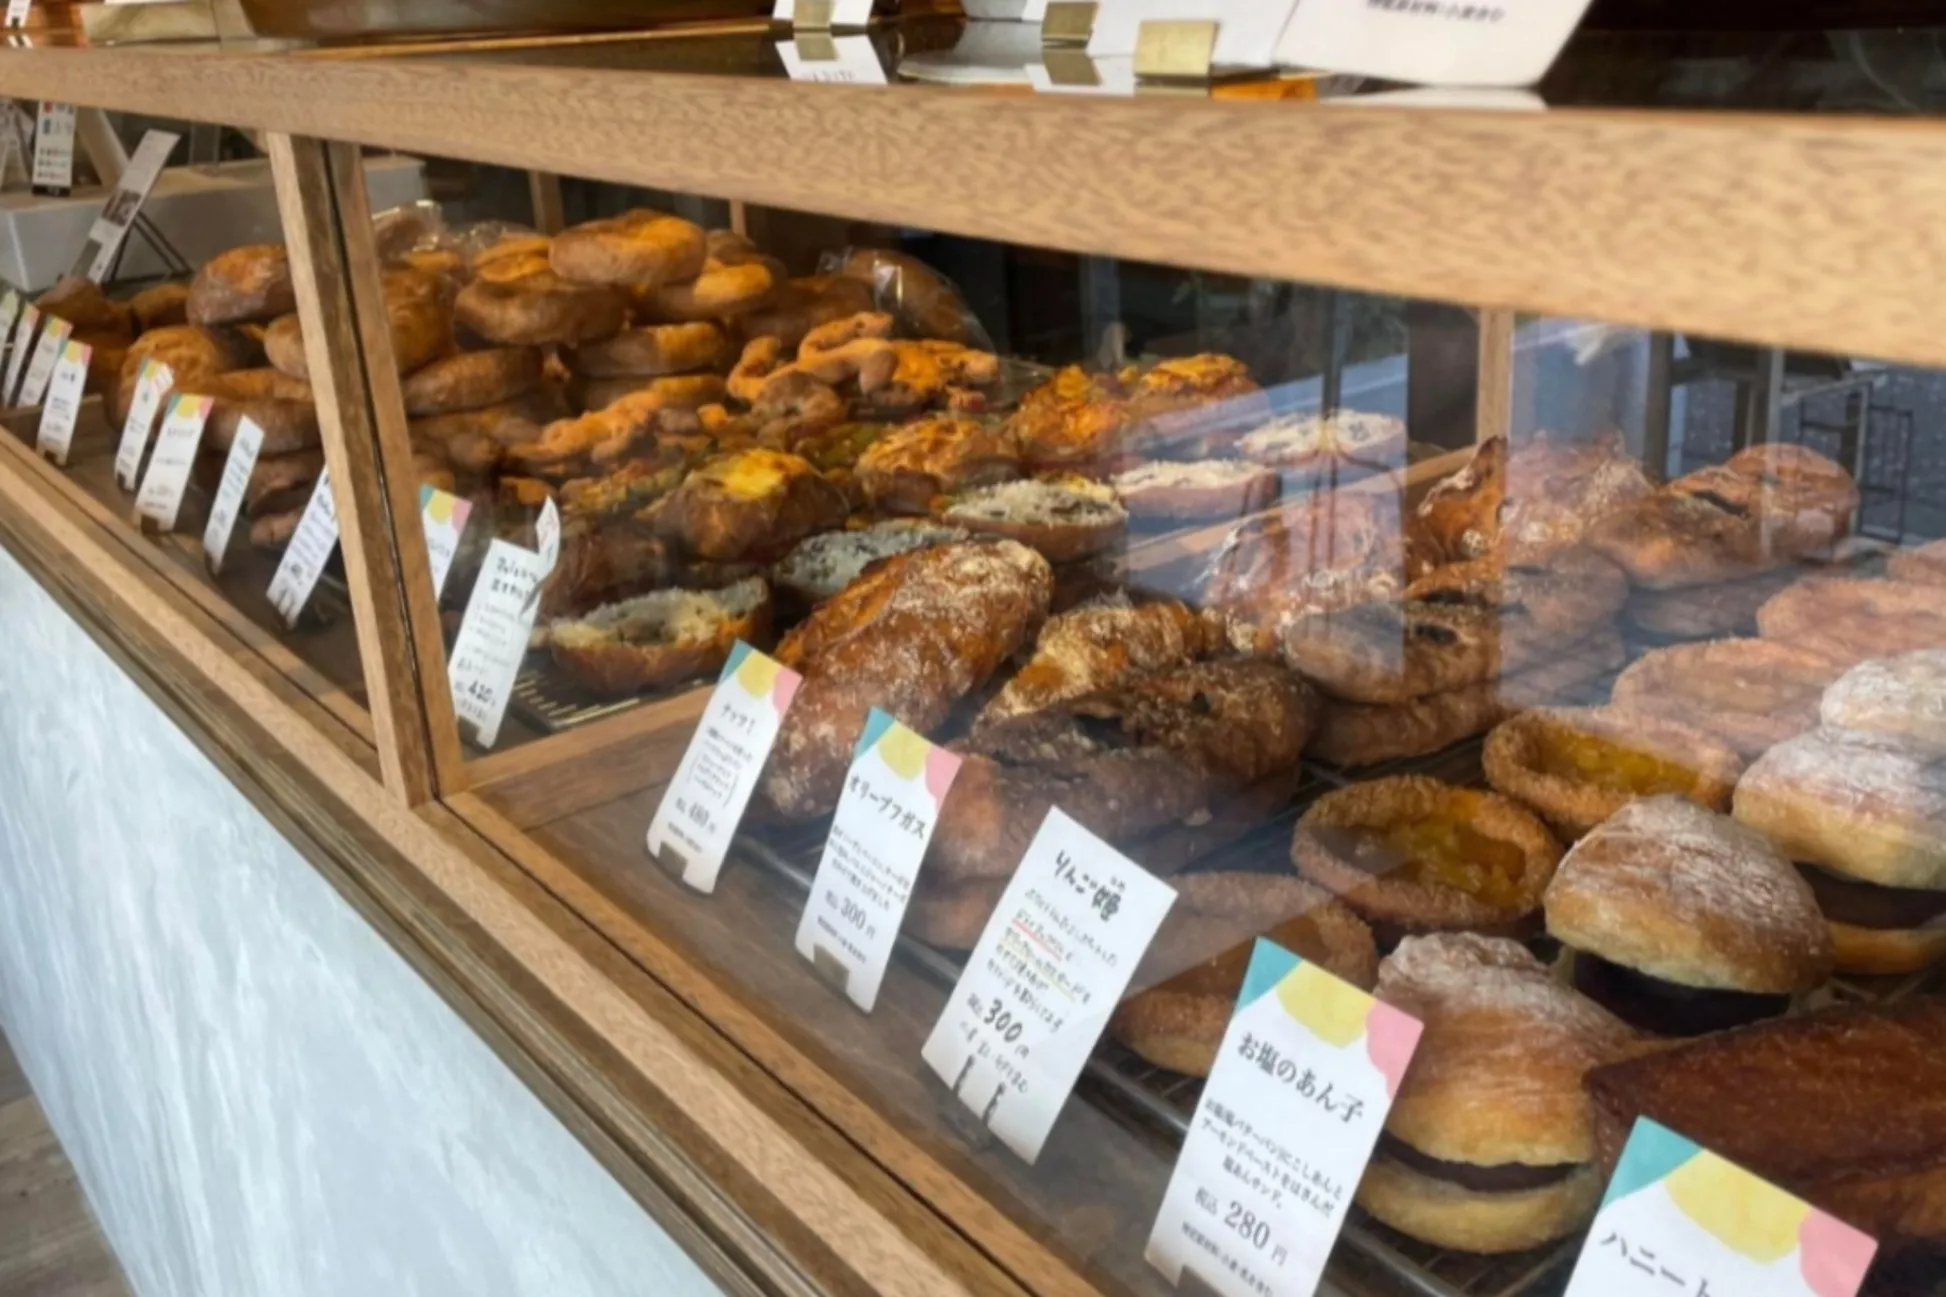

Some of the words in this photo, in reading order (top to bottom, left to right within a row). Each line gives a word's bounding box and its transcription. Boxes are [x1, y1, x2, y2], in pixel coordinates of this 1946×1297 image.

[840, 896, 867, 930] 300
[984, 998, 1023, 1043] 300
[1238, 1032, 1364, 1123] お塩のあん子
[1195, 1186, 1218, 1216] 税込
[1224, 1200, 1270, 1250] 280
[1271, 1244, 1288, 1268] 円
